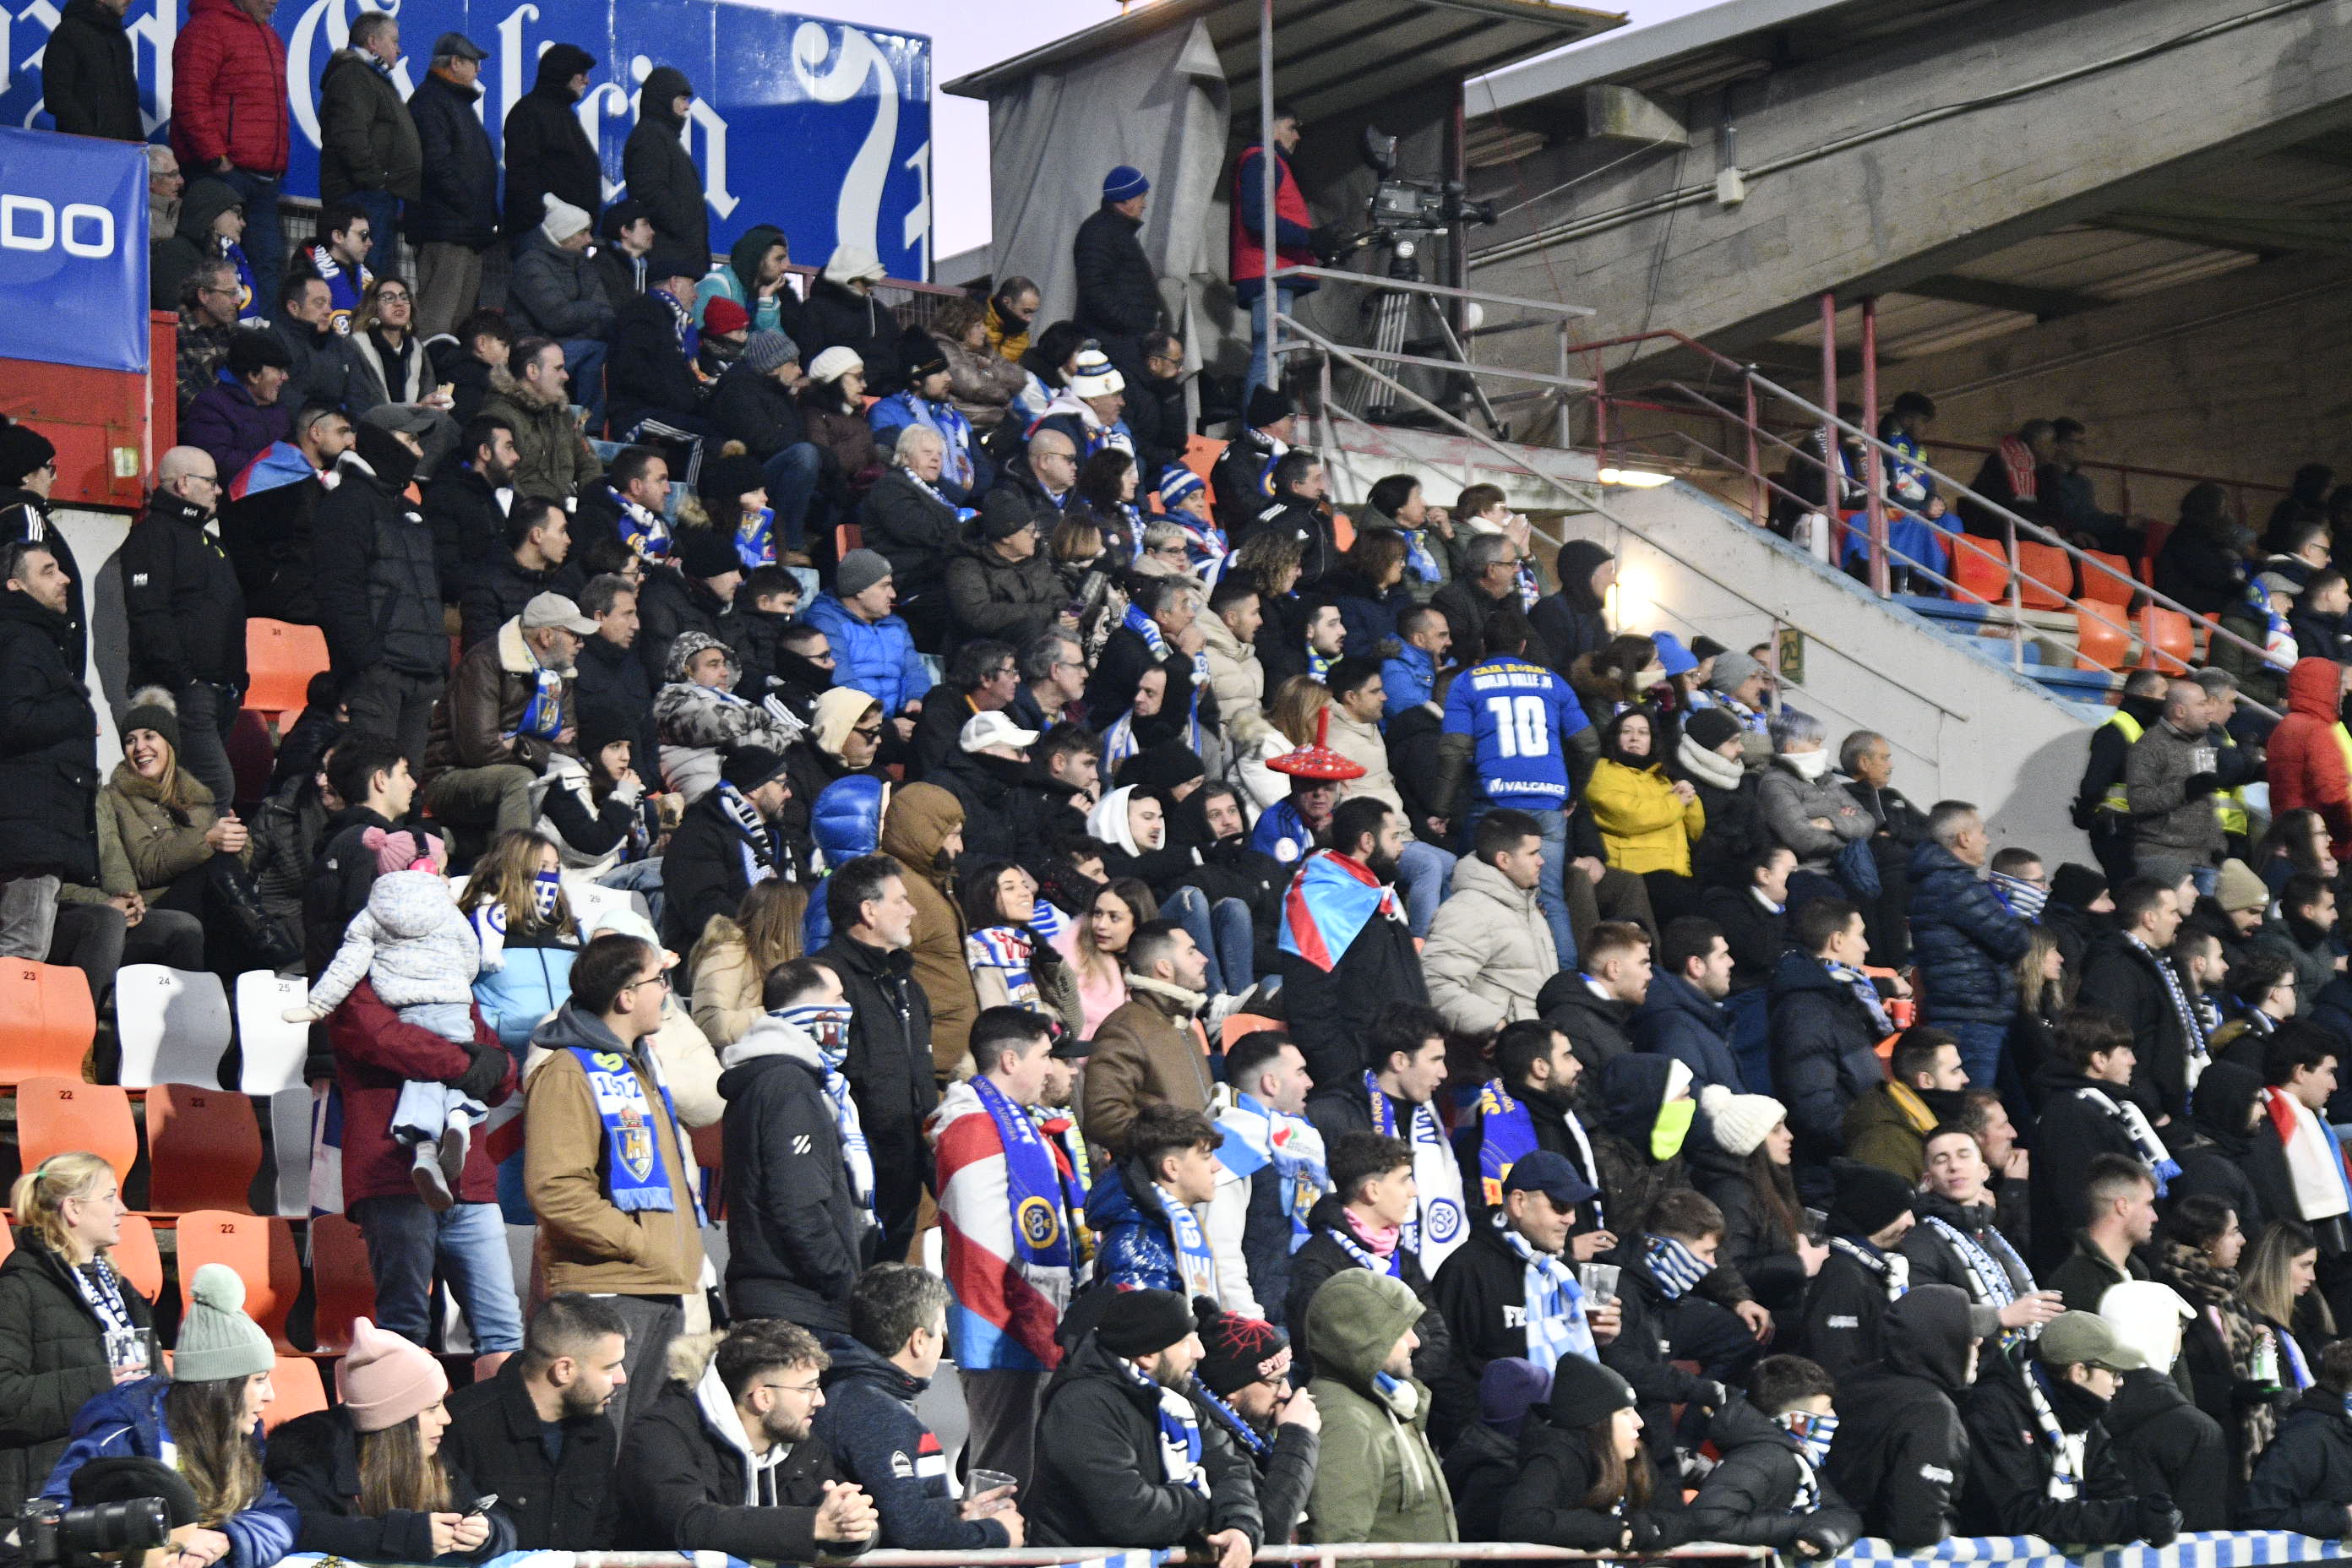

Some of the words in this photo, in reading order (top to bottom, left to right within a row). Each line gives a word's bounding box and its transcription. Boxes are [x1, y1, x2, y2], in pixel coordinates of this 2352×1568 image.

[1486, 695, 1549, 759] 10
[1505, 781, 1566, 795] VALCARCE
[24, 971, 35, 981] 23
[158, 976, 171, 986] 24
[279, 983, 291, 993] 25
[60, 1090, 73, 1100] 22
[220, 1223, 235, 1233] 22
